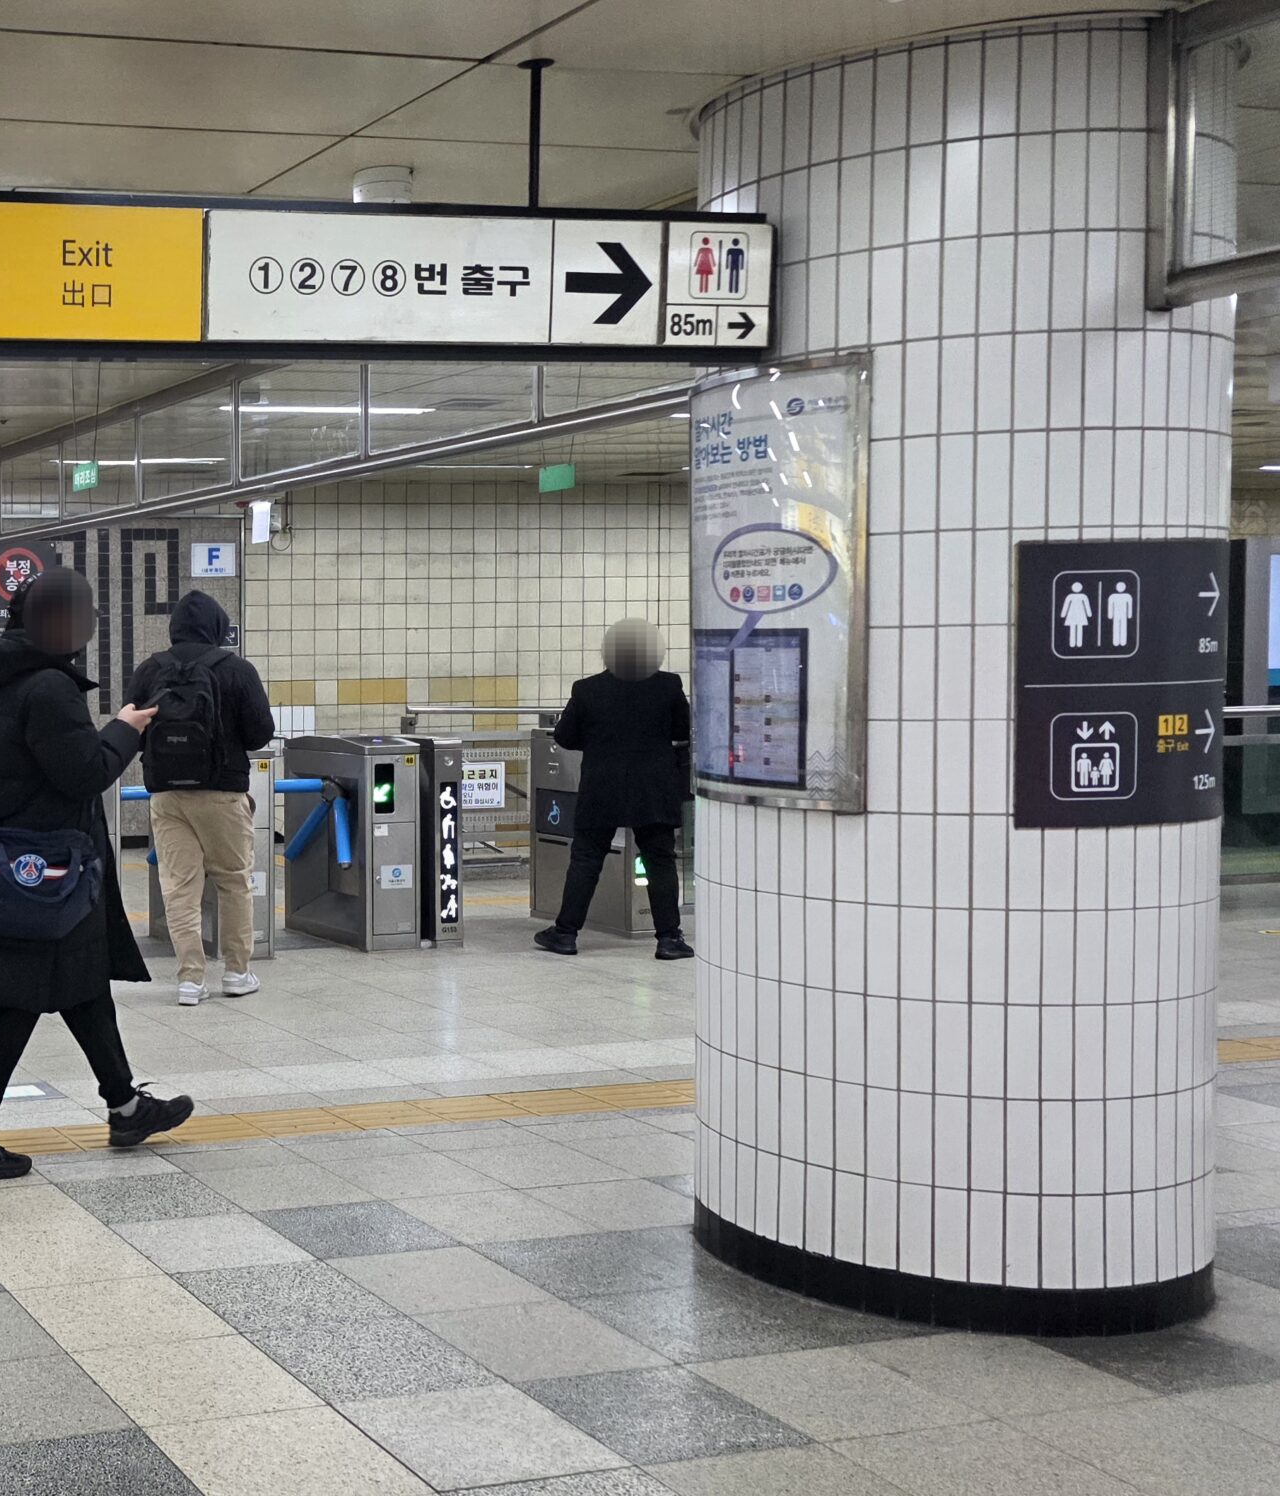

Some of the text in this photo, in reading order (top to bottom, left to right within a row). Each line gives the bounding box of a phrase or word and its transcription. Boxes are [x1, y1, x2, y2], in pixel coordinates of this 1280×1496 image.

[62, 239, 113, 268] Exit
[460, 263, 531, 297] 출구
[62, 280, 112, 308] 出口
[669, 312, 713, 337] 85m
[736, 434, 769, 463] 방법
[207, 547, 221, 566] F
[5, 559, 31, 576] 부정
[5, 576, 25, 592] 승
[1198, 637, 1219, 653] 85m
[1162, 716, 1187, 734] 1 2
[1156, 738, 1176, 754] 출구
[461, 769, 497, 780] 근금지
[1192, 773, 1216, 791] 125m
